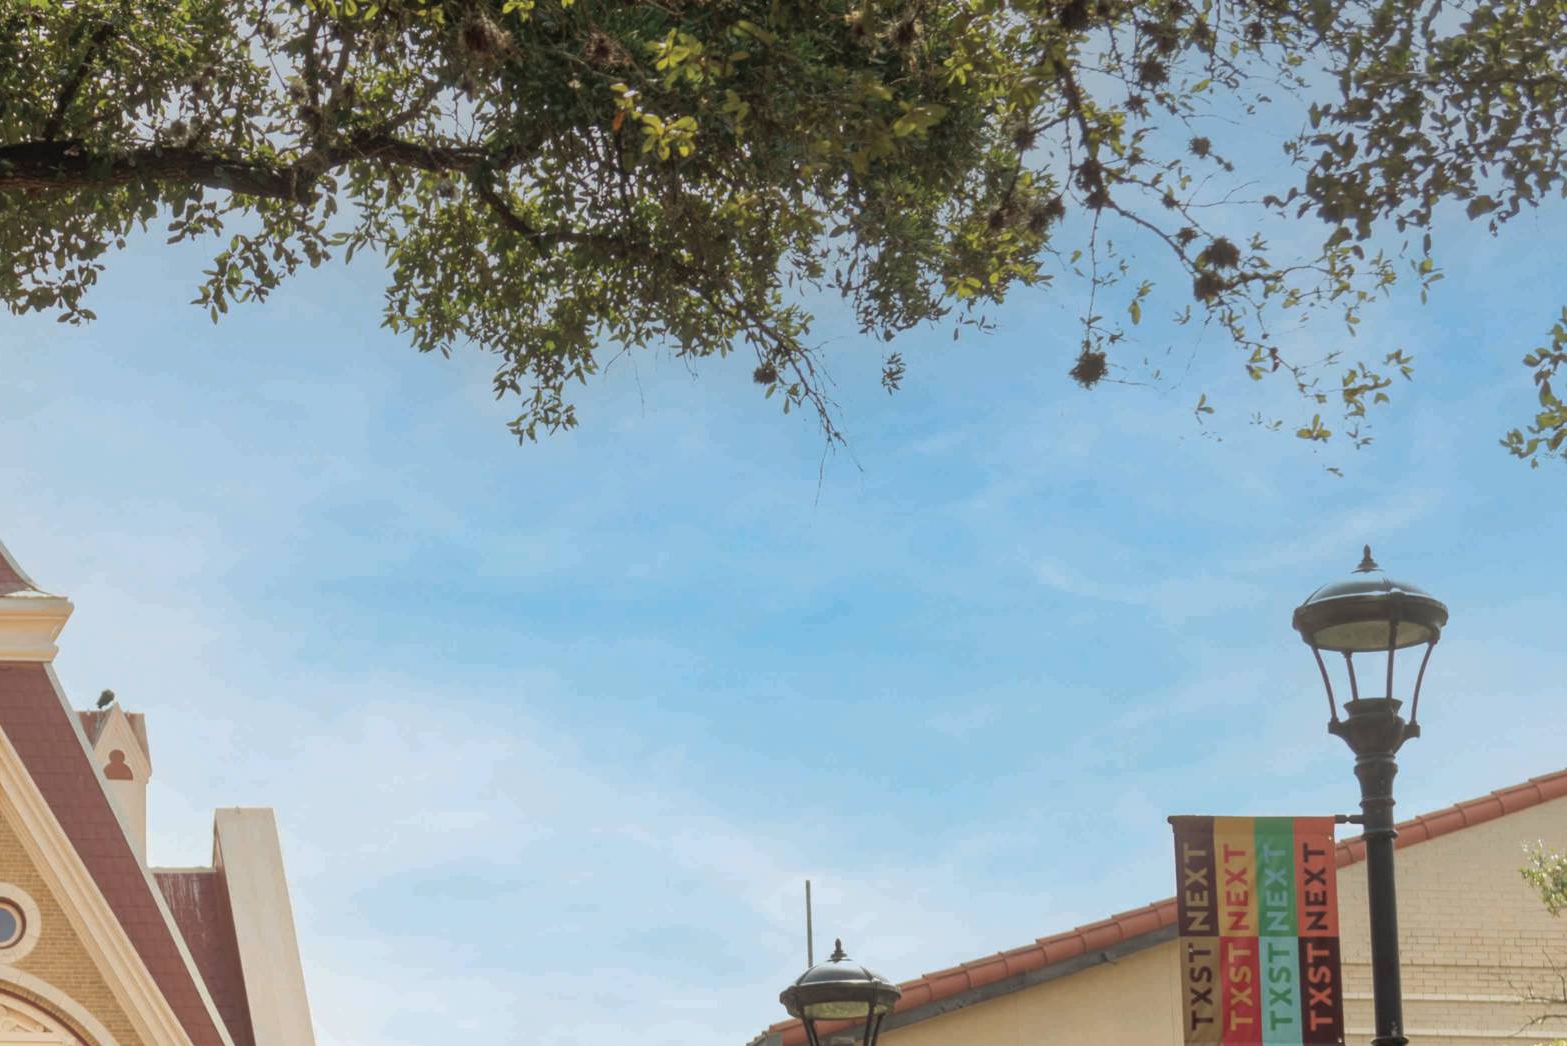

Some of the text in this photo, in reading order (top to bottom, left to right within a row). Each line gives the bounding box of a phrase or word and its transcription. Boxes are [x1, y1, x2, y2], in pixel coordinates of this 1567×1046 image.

[1185, 843, 1213, 1031] TXST NEXT
[1224, 844, 1253, 1031] TXST NEXT
[1264, 843, 1292, 1031] TXST NEXT
[1303, 843, 1332, 1031] TXST NEXT
